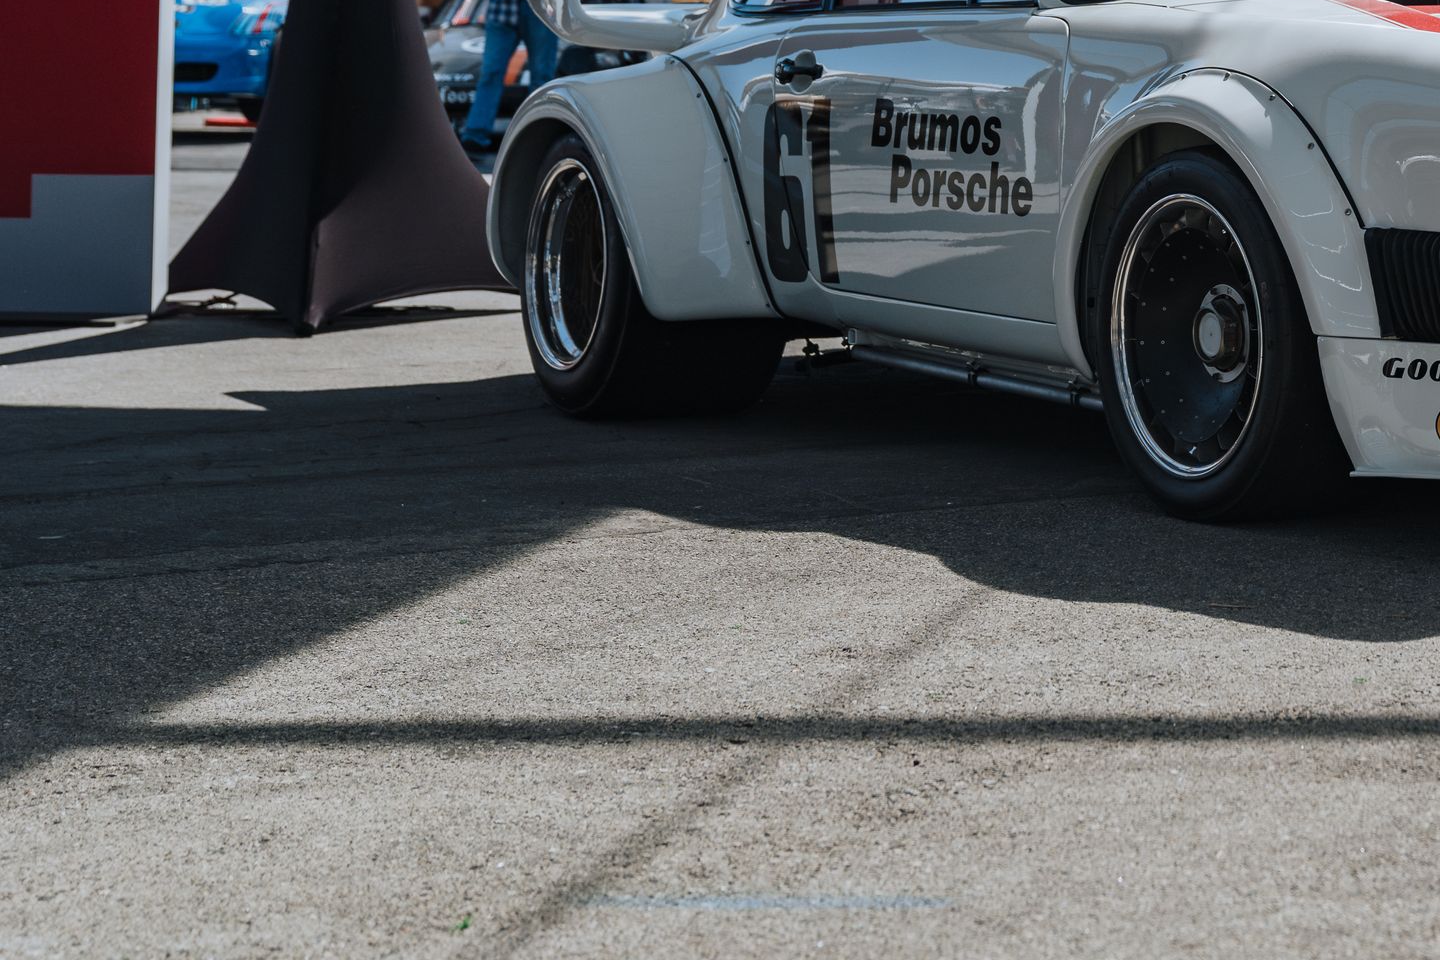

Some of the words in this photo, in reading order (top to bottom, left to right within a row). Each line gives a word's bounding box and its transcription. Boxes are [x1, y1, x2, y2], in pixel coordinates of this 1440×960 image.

[871, 97, 1002, 156] Brumos
[763, 98, 840, 284] 61
[890, 153, 1033, 217] Porsche
